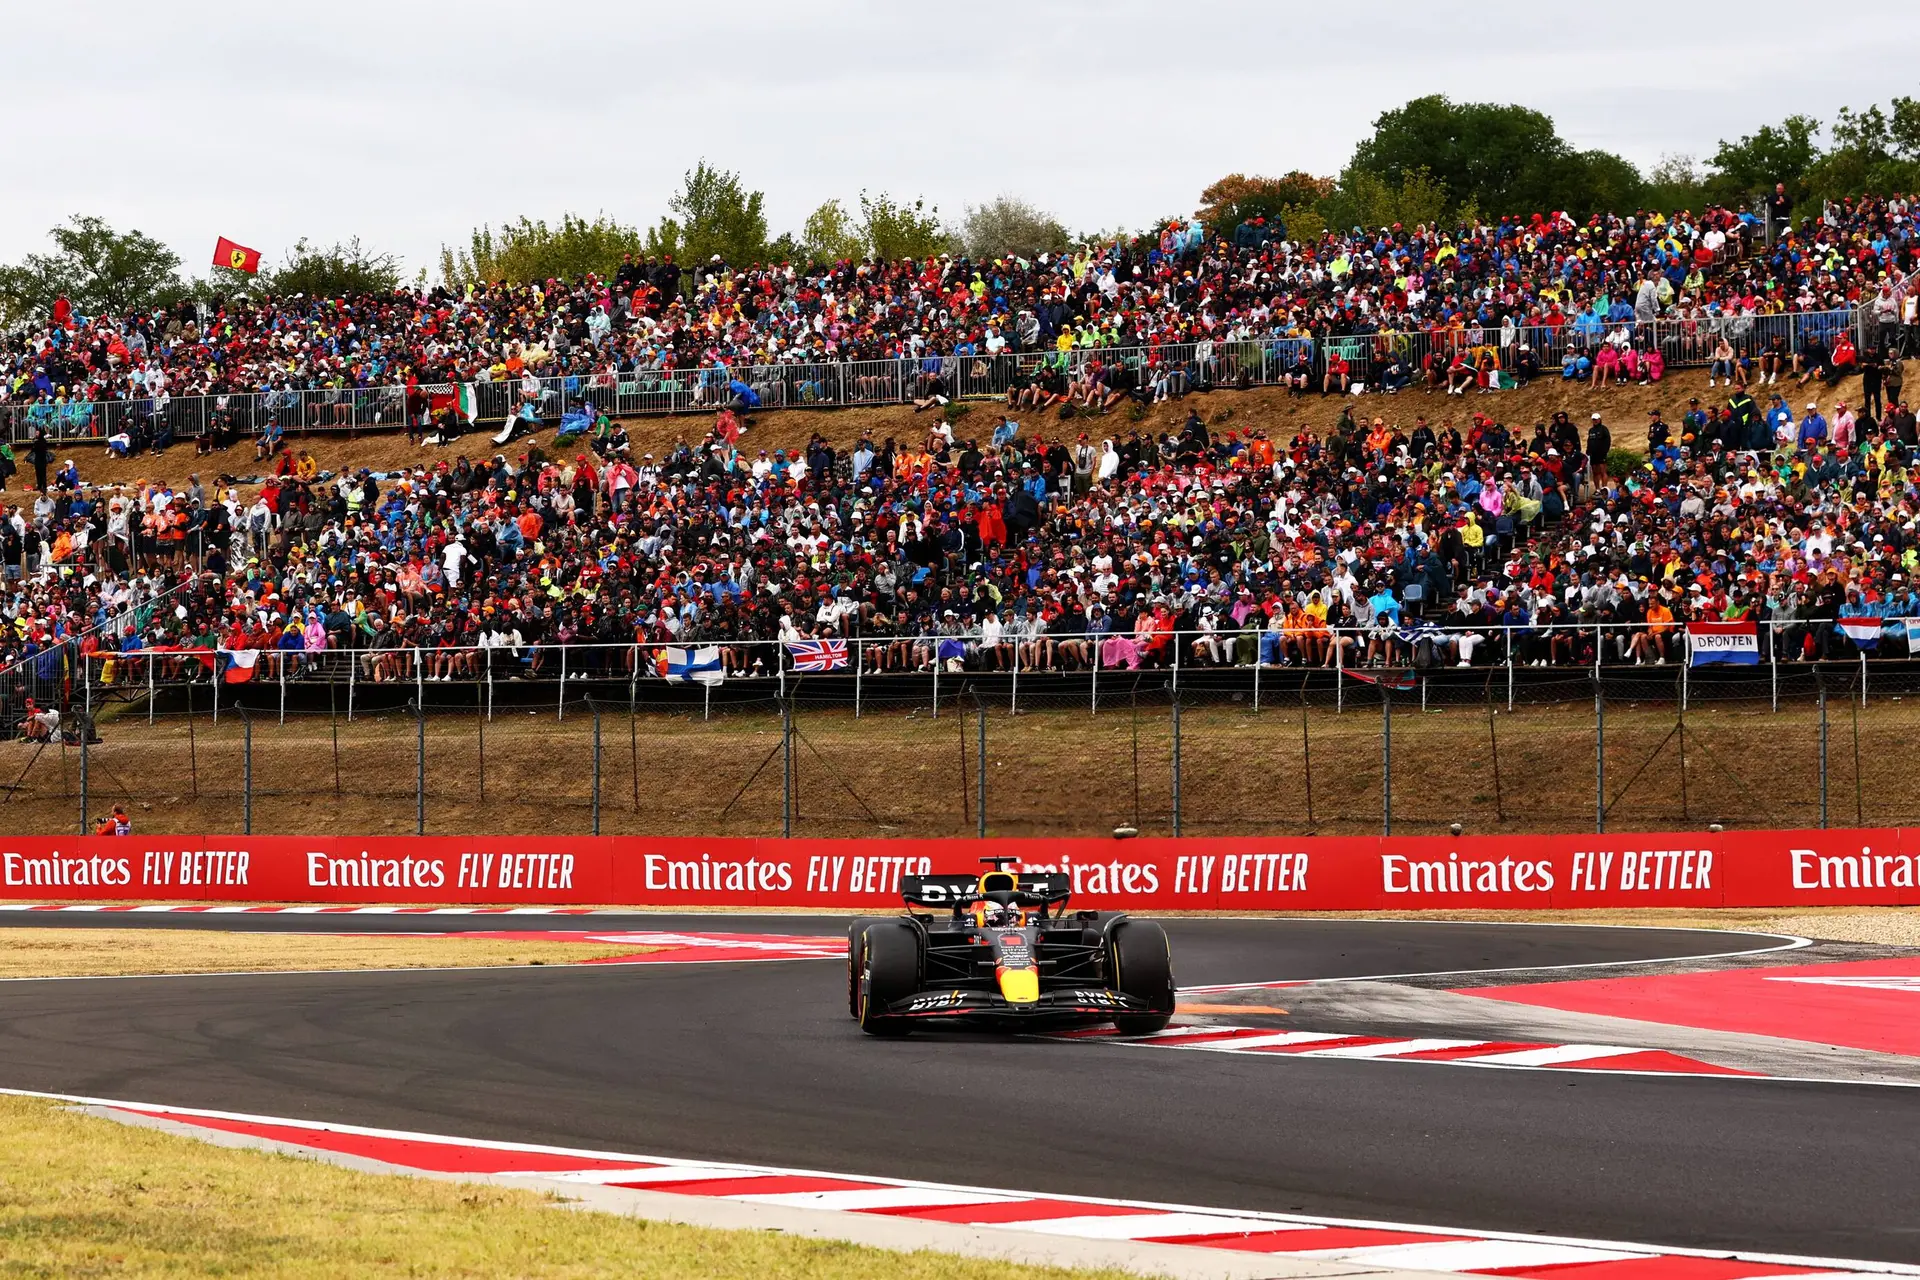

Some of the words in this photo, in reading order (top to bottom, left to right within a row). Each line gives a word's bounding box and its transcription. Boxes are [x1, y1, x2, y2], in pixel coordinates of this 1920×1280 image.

[1698, 635, 1753, 648] DRONTEN
[3, 851, 131, 886] Emirates
[143, 851, 174, 885] FLY
[178, 851, 249, 886] BETTER
[307, 851, 444, 888] Emirates
[458, 853, 493, 887] FLY
[498, 853, 573, 889] BETTER
[643, 853, 792, 892] Emirates
[806, 856, 844, 892] FLY
[1174, 855, 1215, 893] FLY
[1221, 853, 1308, 892] BETTER
[1381, 852, 1554, 892] Emirates
[1571, 851, 1613, 891] FLY
[1620, 850, 1712, 890] BETTER
[1790, 846, 1920, 889] Emira
